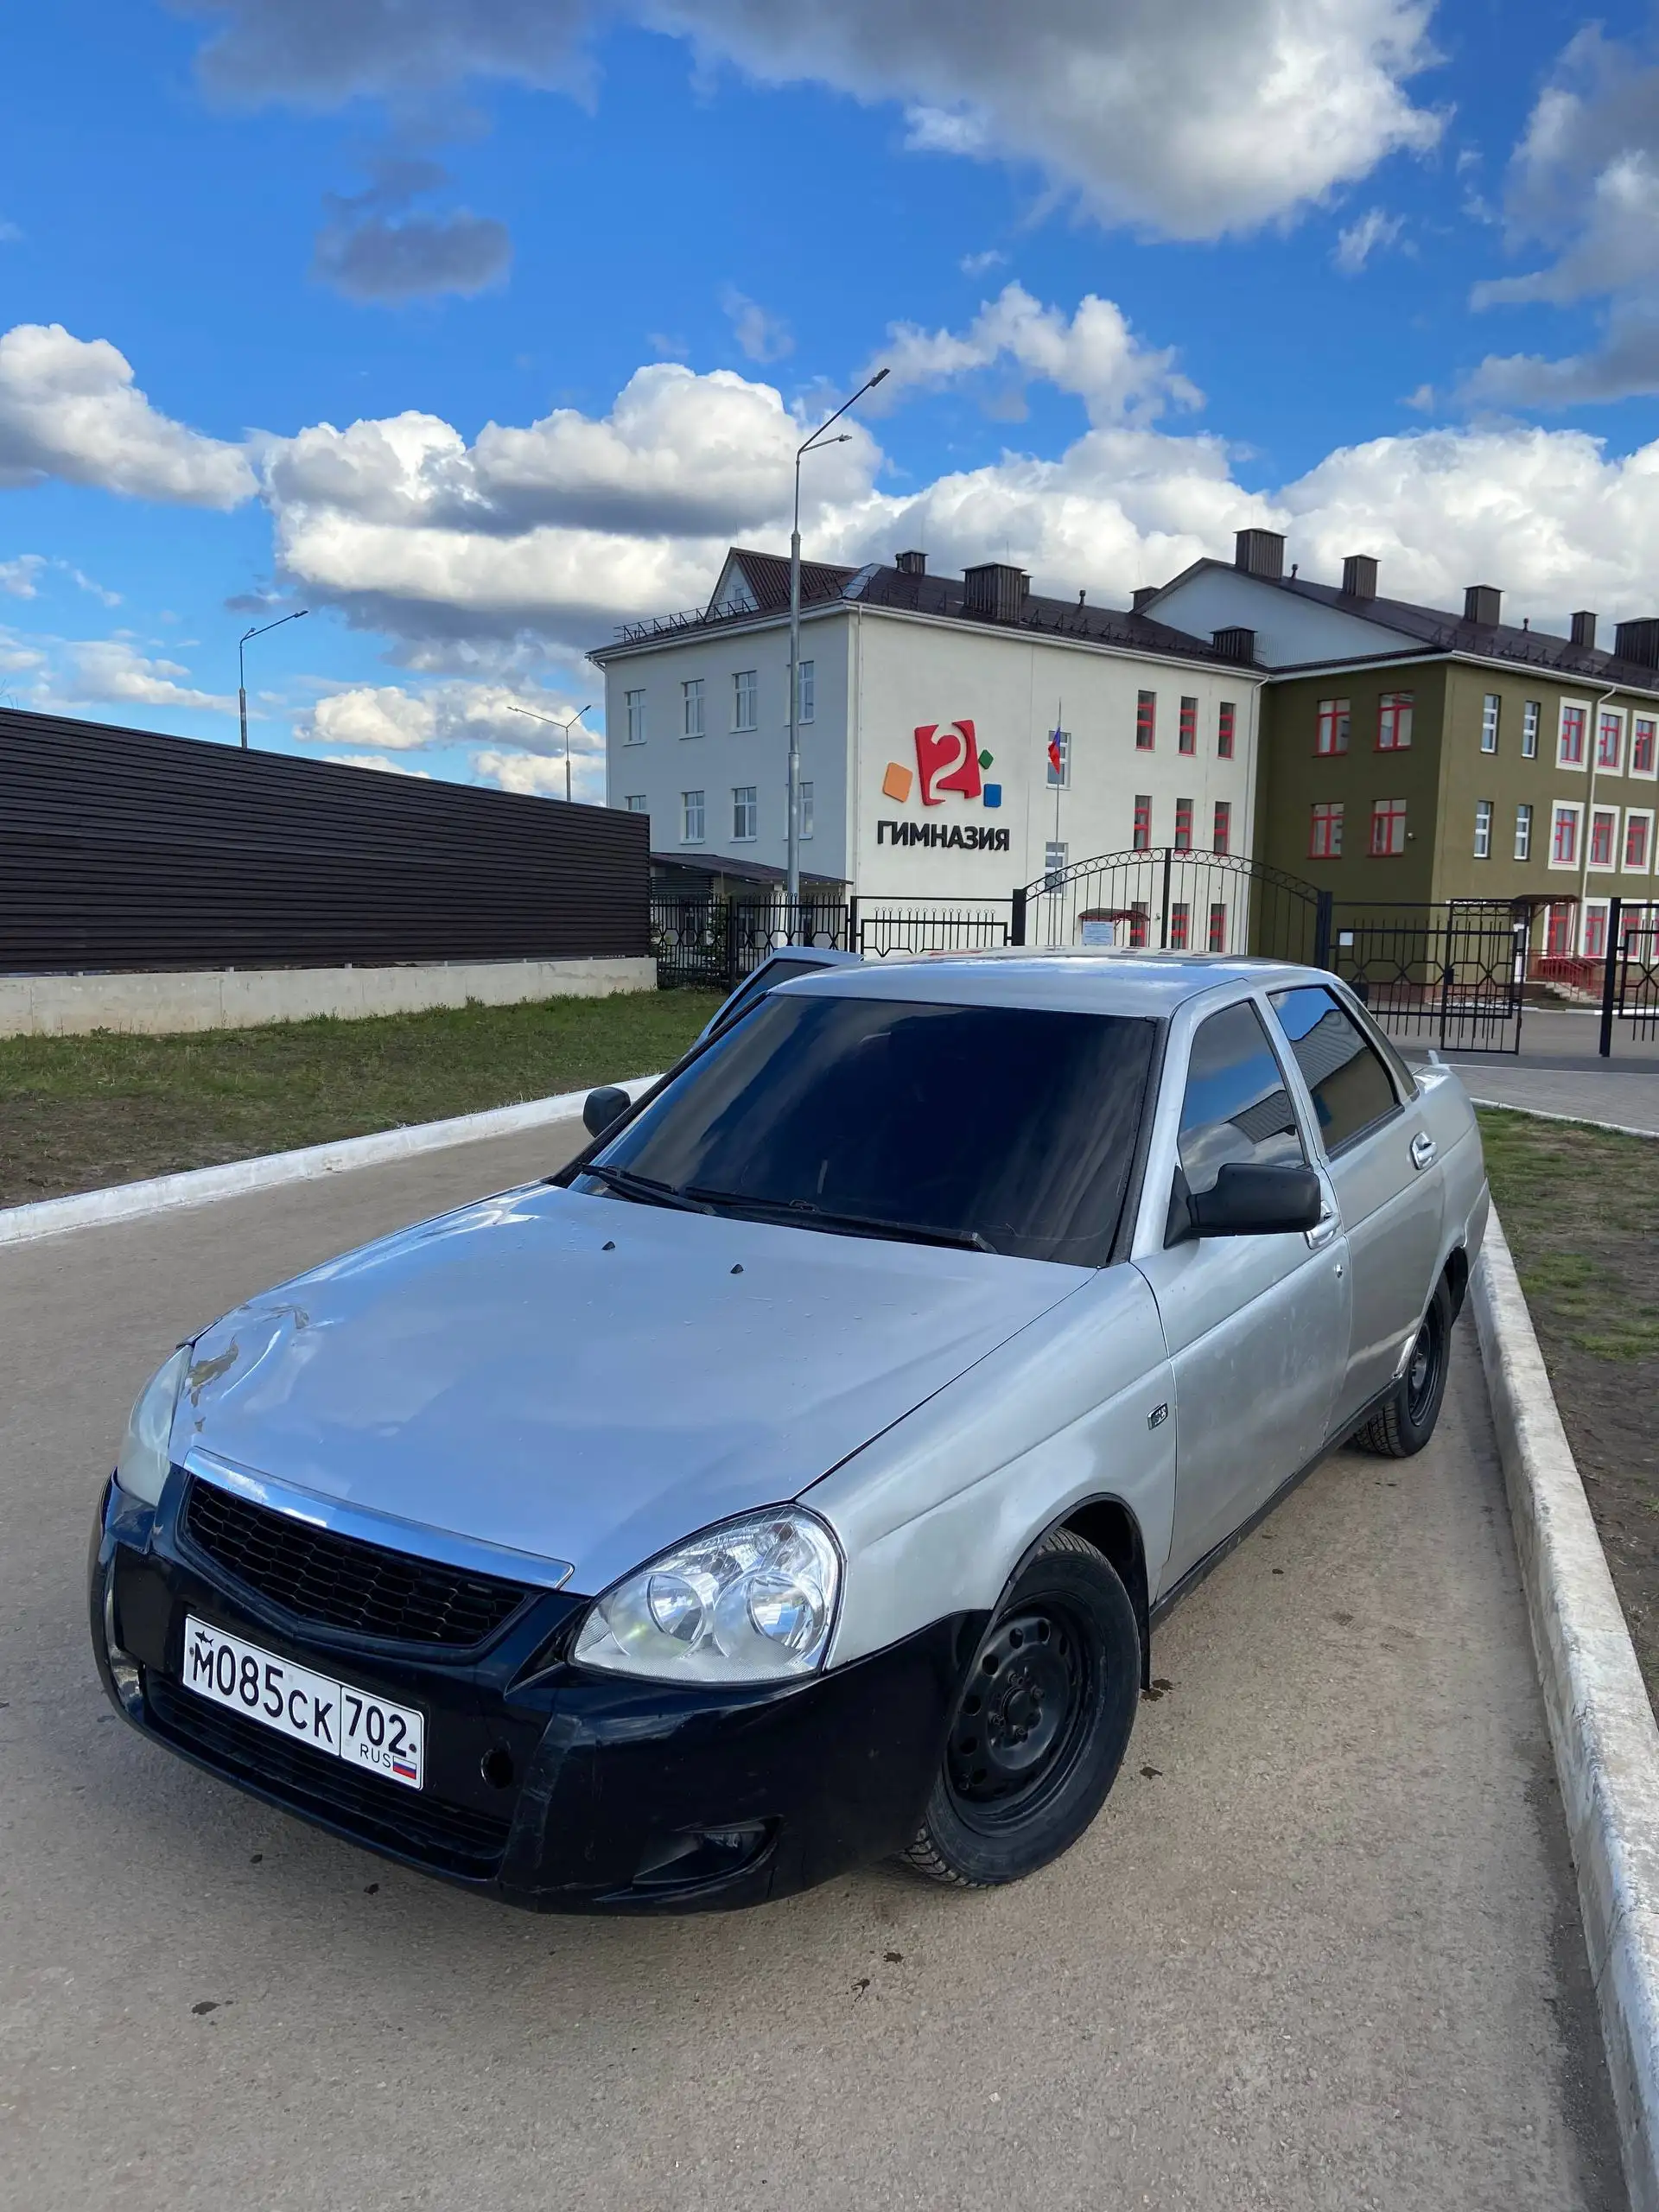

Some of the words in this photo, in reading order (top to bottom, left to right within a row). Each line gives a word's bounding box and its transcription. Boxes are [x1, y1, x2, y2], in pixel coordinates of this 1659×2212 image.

[928, 720, 968, 802] 2
[877, 820, 1010, 851] ГИМНАЗИЯ
[346, 1694, 407, 1758] 702
[359, 1743, 391, 1769] RUS
